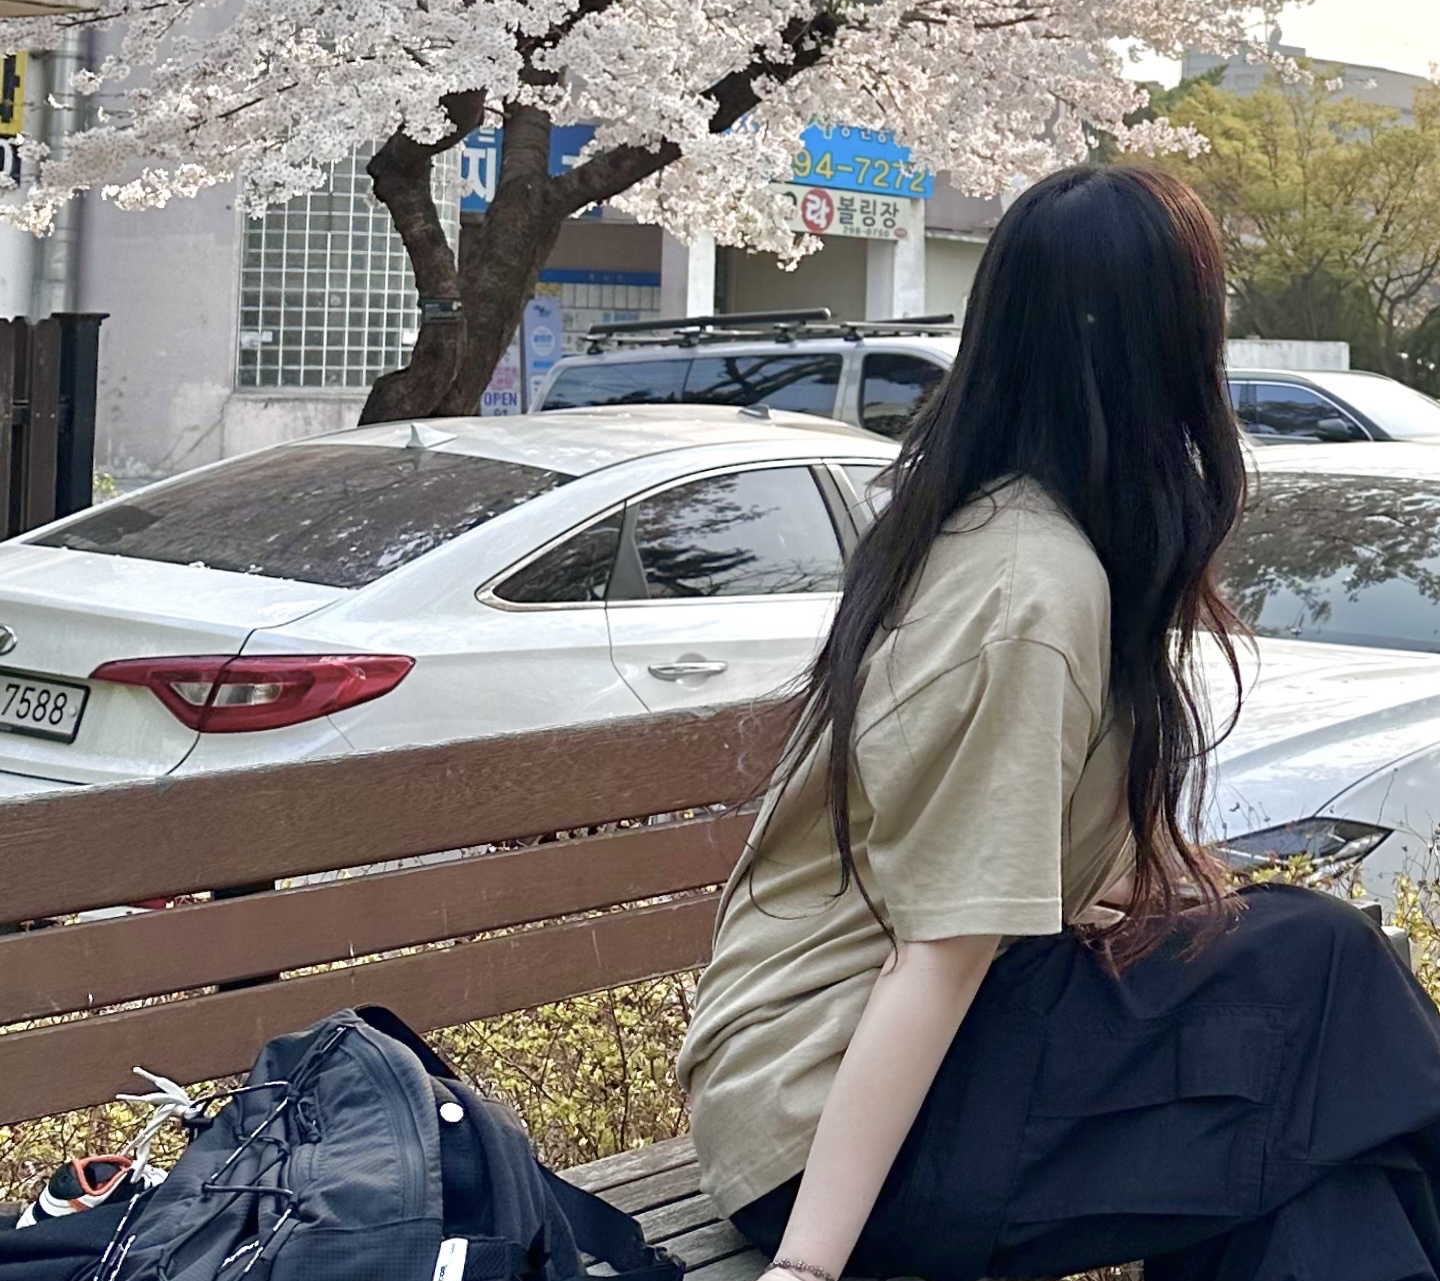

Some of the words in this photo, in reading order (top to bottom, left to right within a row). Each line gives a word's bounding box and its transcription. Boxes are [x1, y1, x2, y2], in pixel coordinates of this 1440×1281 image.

[836, 195, 900, 229] 볼링장
[484, 392, 518, 407] OPEN
[1, 683, 68, 726] 7588
